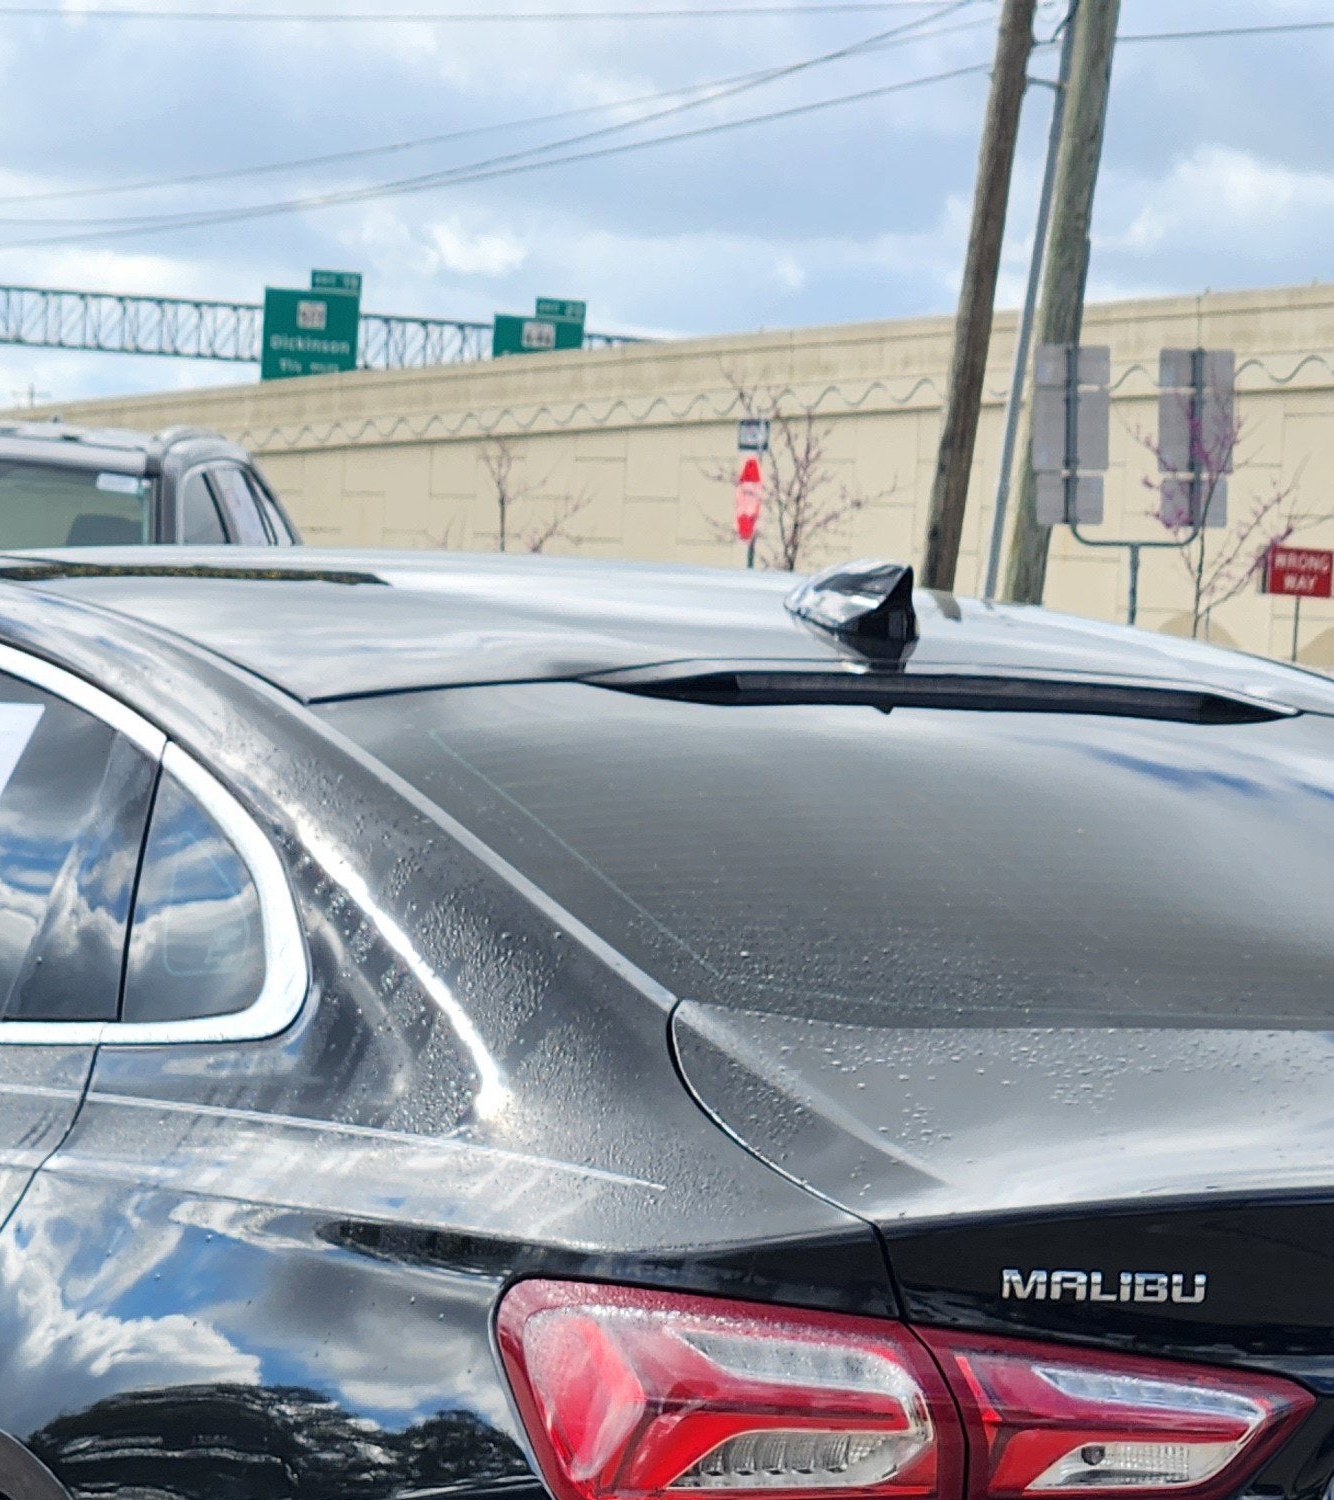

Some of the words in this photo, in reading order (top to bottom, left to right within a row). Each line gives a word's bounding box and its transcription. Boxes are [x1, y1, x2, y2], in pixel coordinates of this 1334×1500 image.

[1275, 552, 1331, 573] WRONG
[1284, 573, 1319, 594] WAY
[1001, 1269, 1207, 1304] MALIBU
